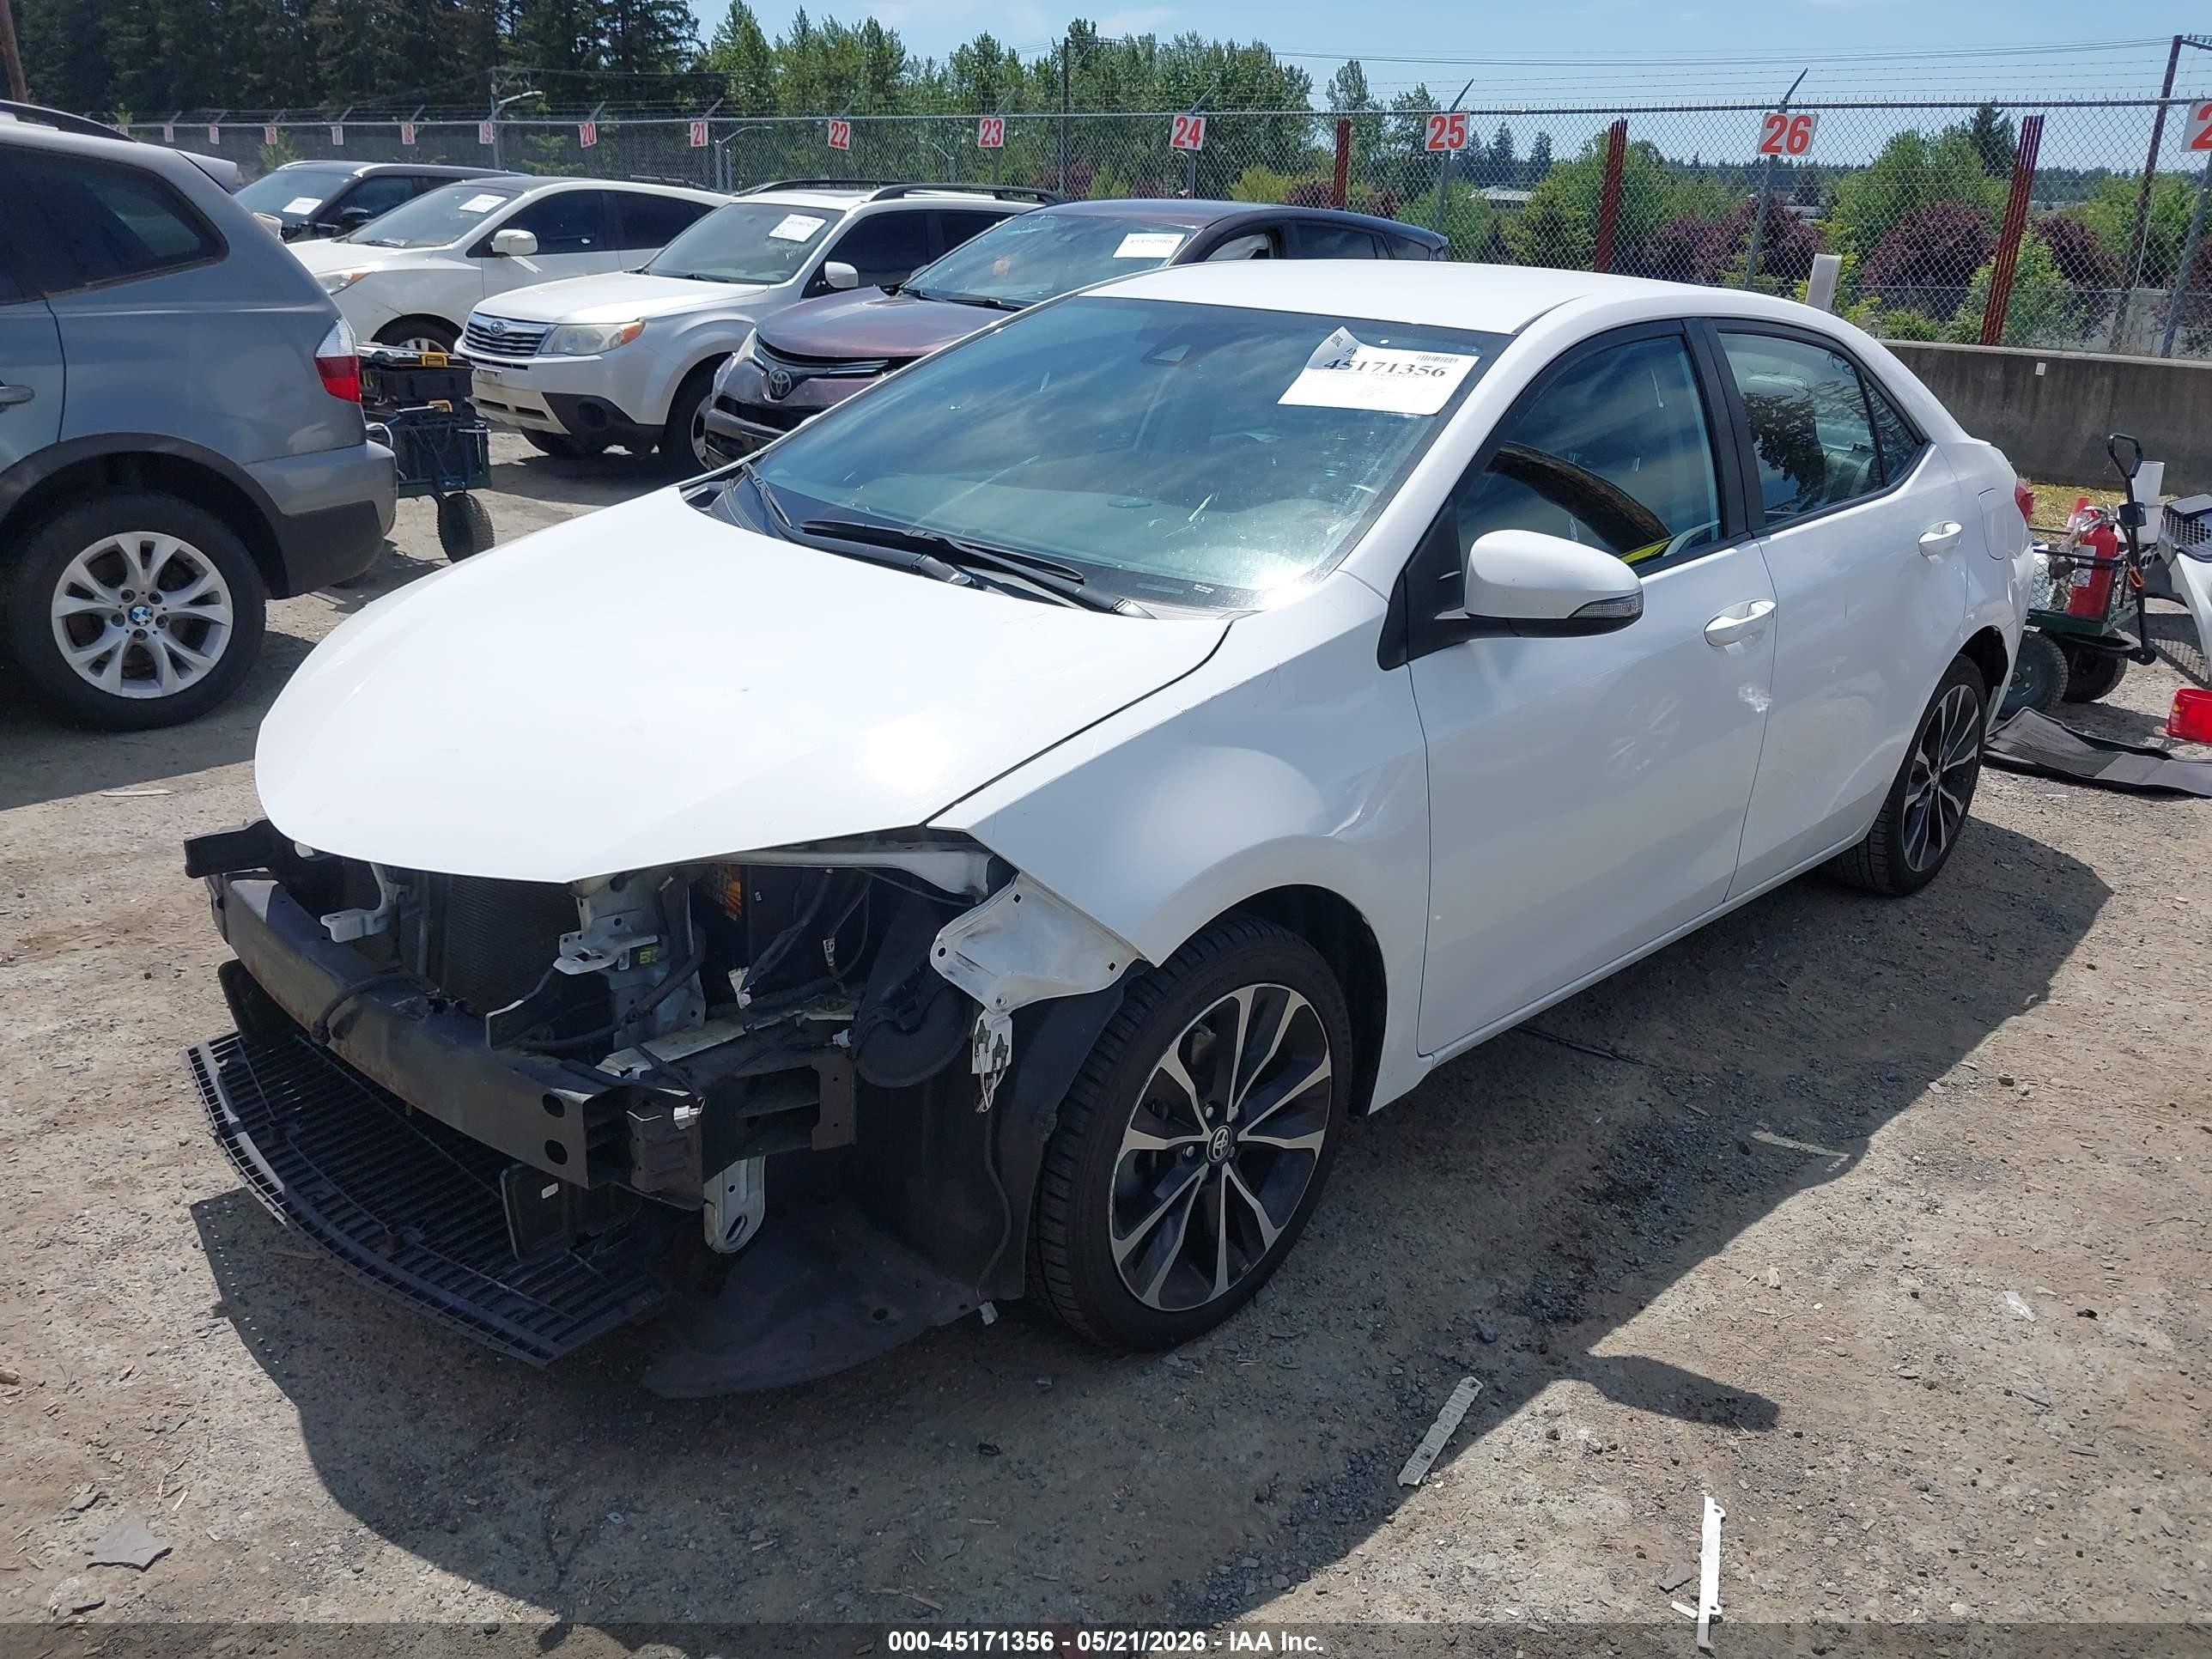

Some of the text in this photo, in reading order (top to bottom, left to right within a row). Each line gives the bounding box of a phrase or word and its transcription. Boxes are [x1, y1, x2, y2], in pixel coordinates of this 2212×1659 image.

[581, 123, 595, 146] 20
[693, 123, 706, 145] 21
[830, 122, 848, 148] 22
[980, 118, 1003, 146] 23
[1172, 117, 1201, 148] 24
[1428, 115, 1465, 149] 25
[1760, 115, 1812, 154] 26
[1323, 357, 1451, 378] 45171356
